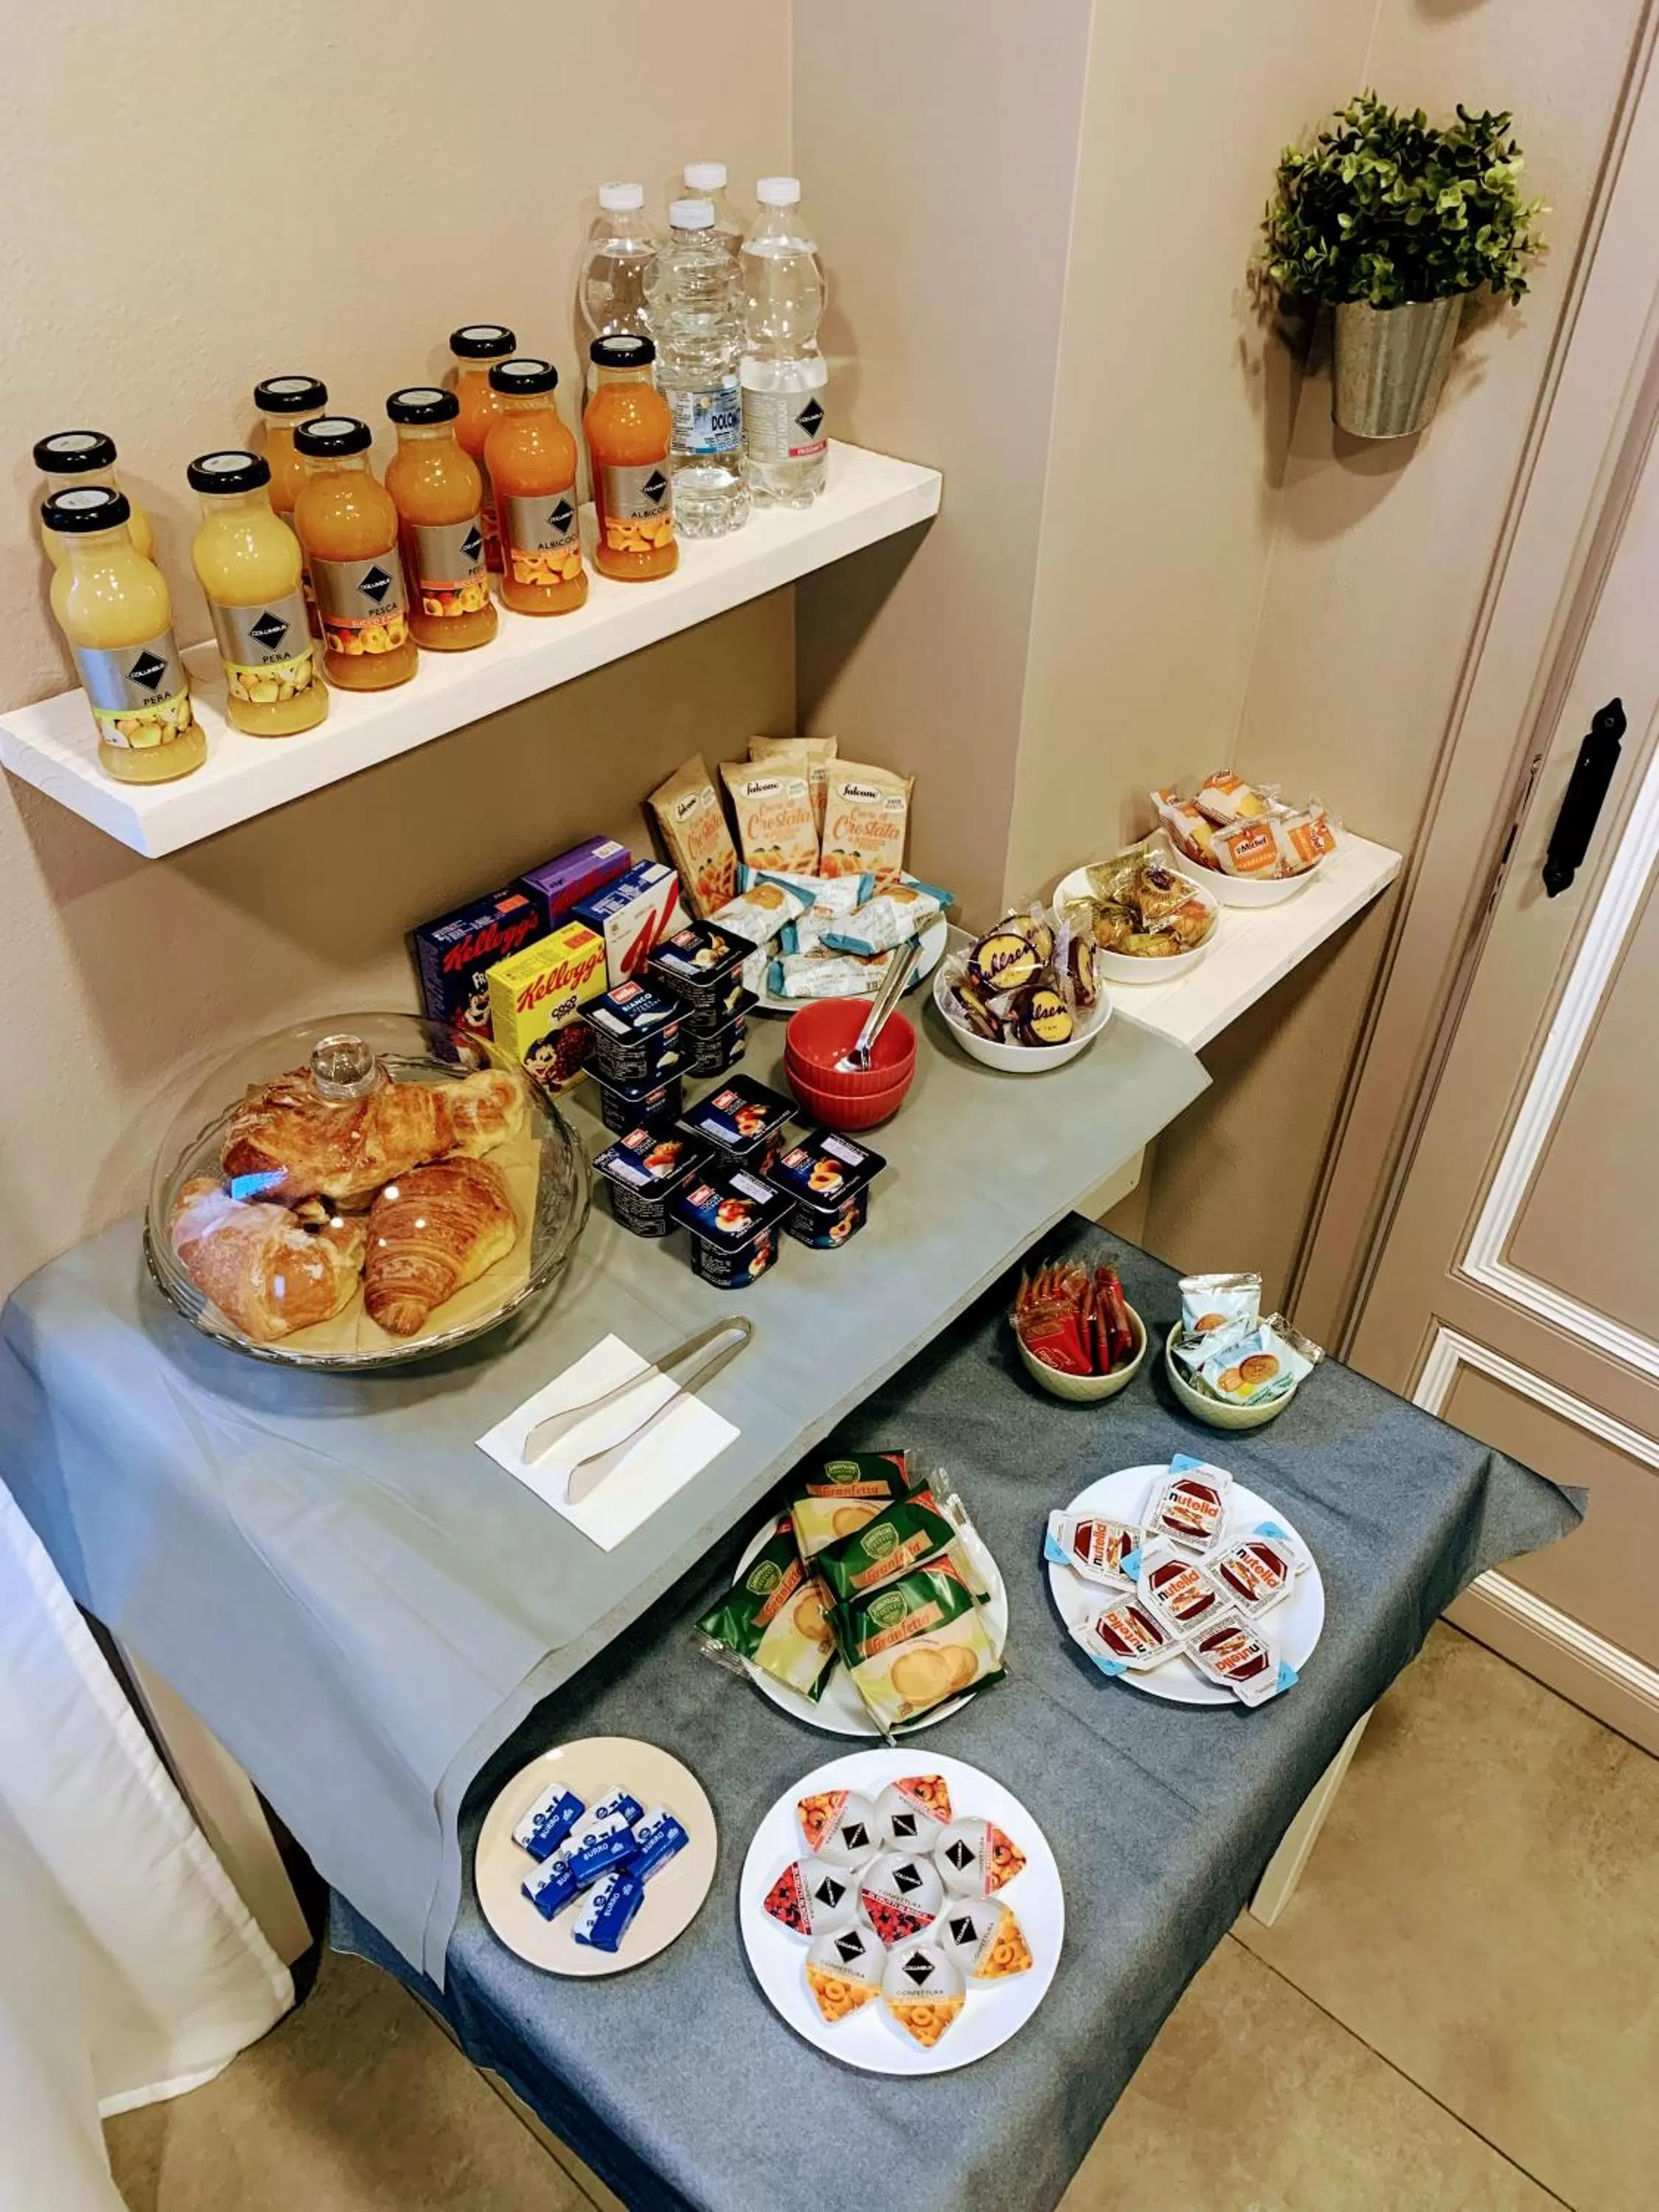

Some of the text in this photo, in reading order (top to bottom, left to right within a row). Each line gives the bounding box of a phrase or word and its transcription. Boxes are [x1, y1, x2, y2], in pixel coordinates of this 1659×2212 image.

[262, 652, 291, 663] PERA
[143, 691, 171, 706] PERA
[517, 944, 606, 1013] Kellogg's
[622, 993, 653, 1012] BIANCO
[1169, 1492, 1221, 1518] nutella
[1093, 1523, 1106, 1566] nutella
[1236, 1549, 1282, 1589] nutella
[1158, 1570, 1200, 1601] nutella
[1106, 1612, 1147, 1653] nutella
[1214, 1644, 1260, 1671] nutella
